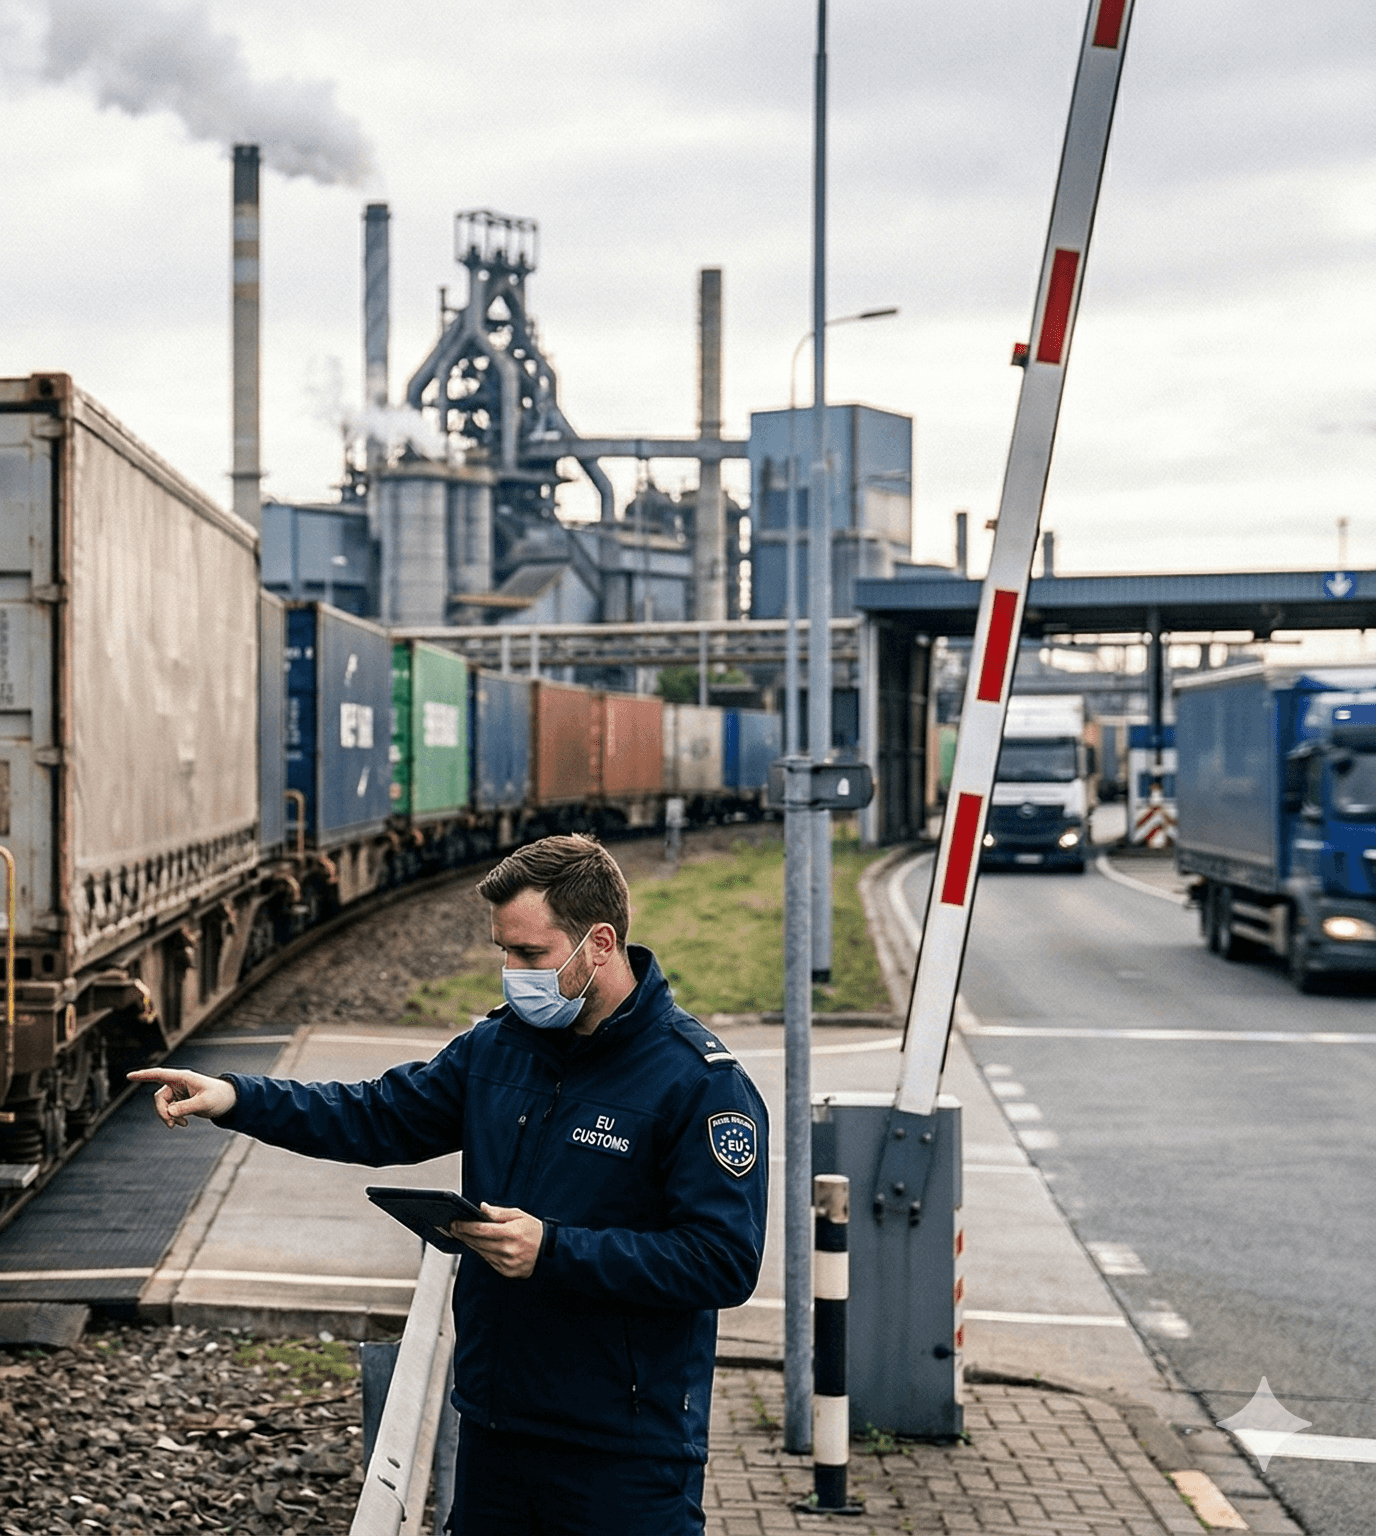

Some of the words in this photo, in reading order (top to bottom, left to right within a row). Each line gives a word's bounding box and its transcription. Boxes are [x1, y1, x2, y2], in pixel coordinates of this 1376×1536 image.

[595, 1115, 615, 1131] EU
[572, 1127, 630, 1152] CUSTOMS
[727, 1139, 744, 1152] EU
